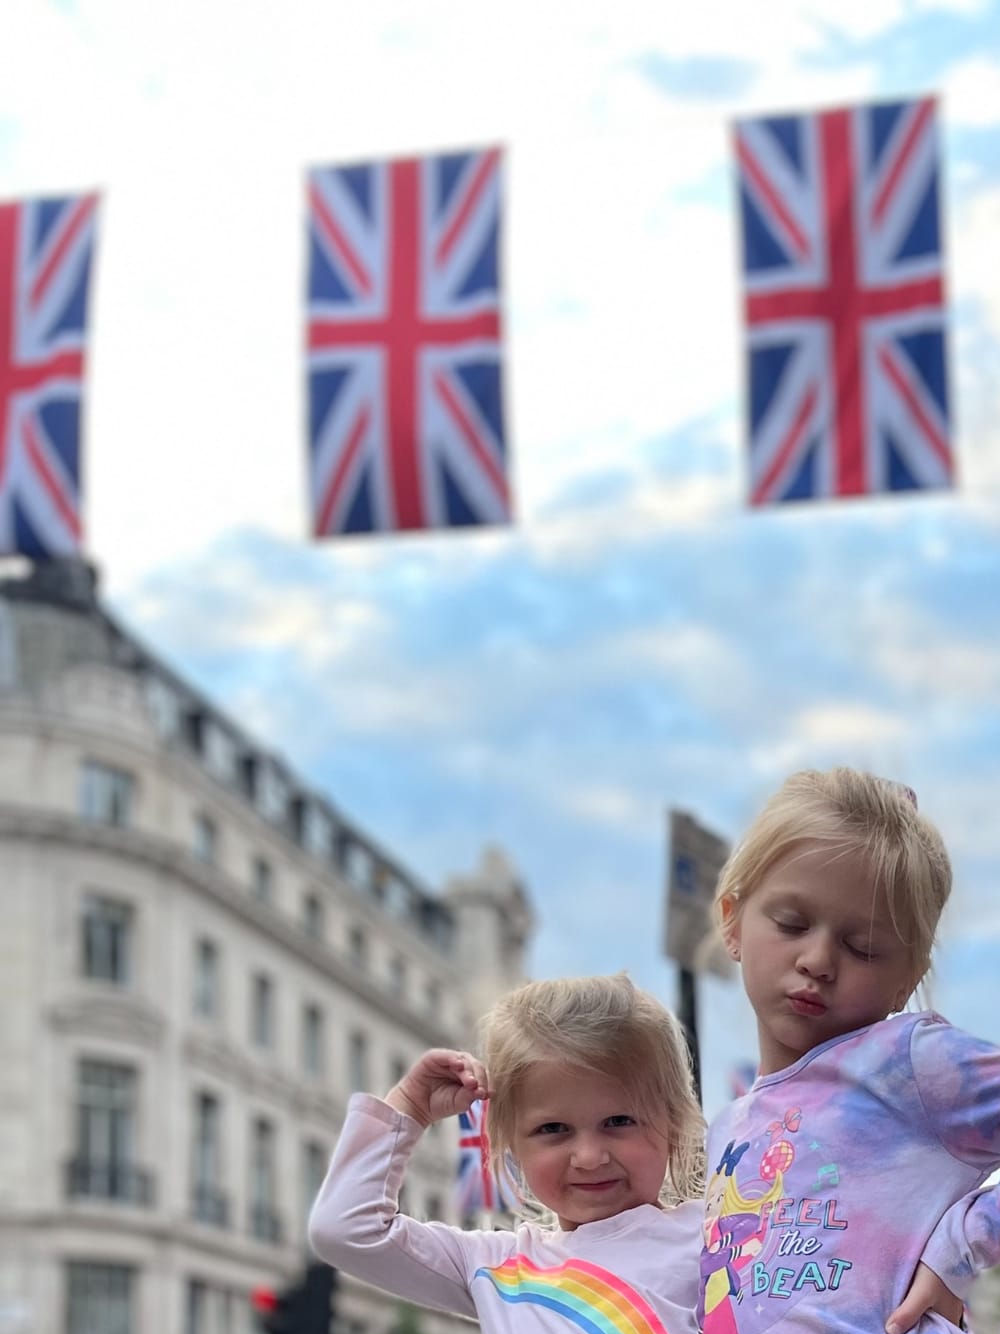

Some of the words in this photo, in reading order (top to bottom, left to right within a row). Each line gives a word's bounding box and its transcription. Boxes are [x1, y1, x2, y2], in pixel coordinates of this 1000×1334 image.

[761, 1198, 848, 1230] FEEL
[778, 1230, 822, 1256] the
[752, 1258, 852, 1299] BEAT
